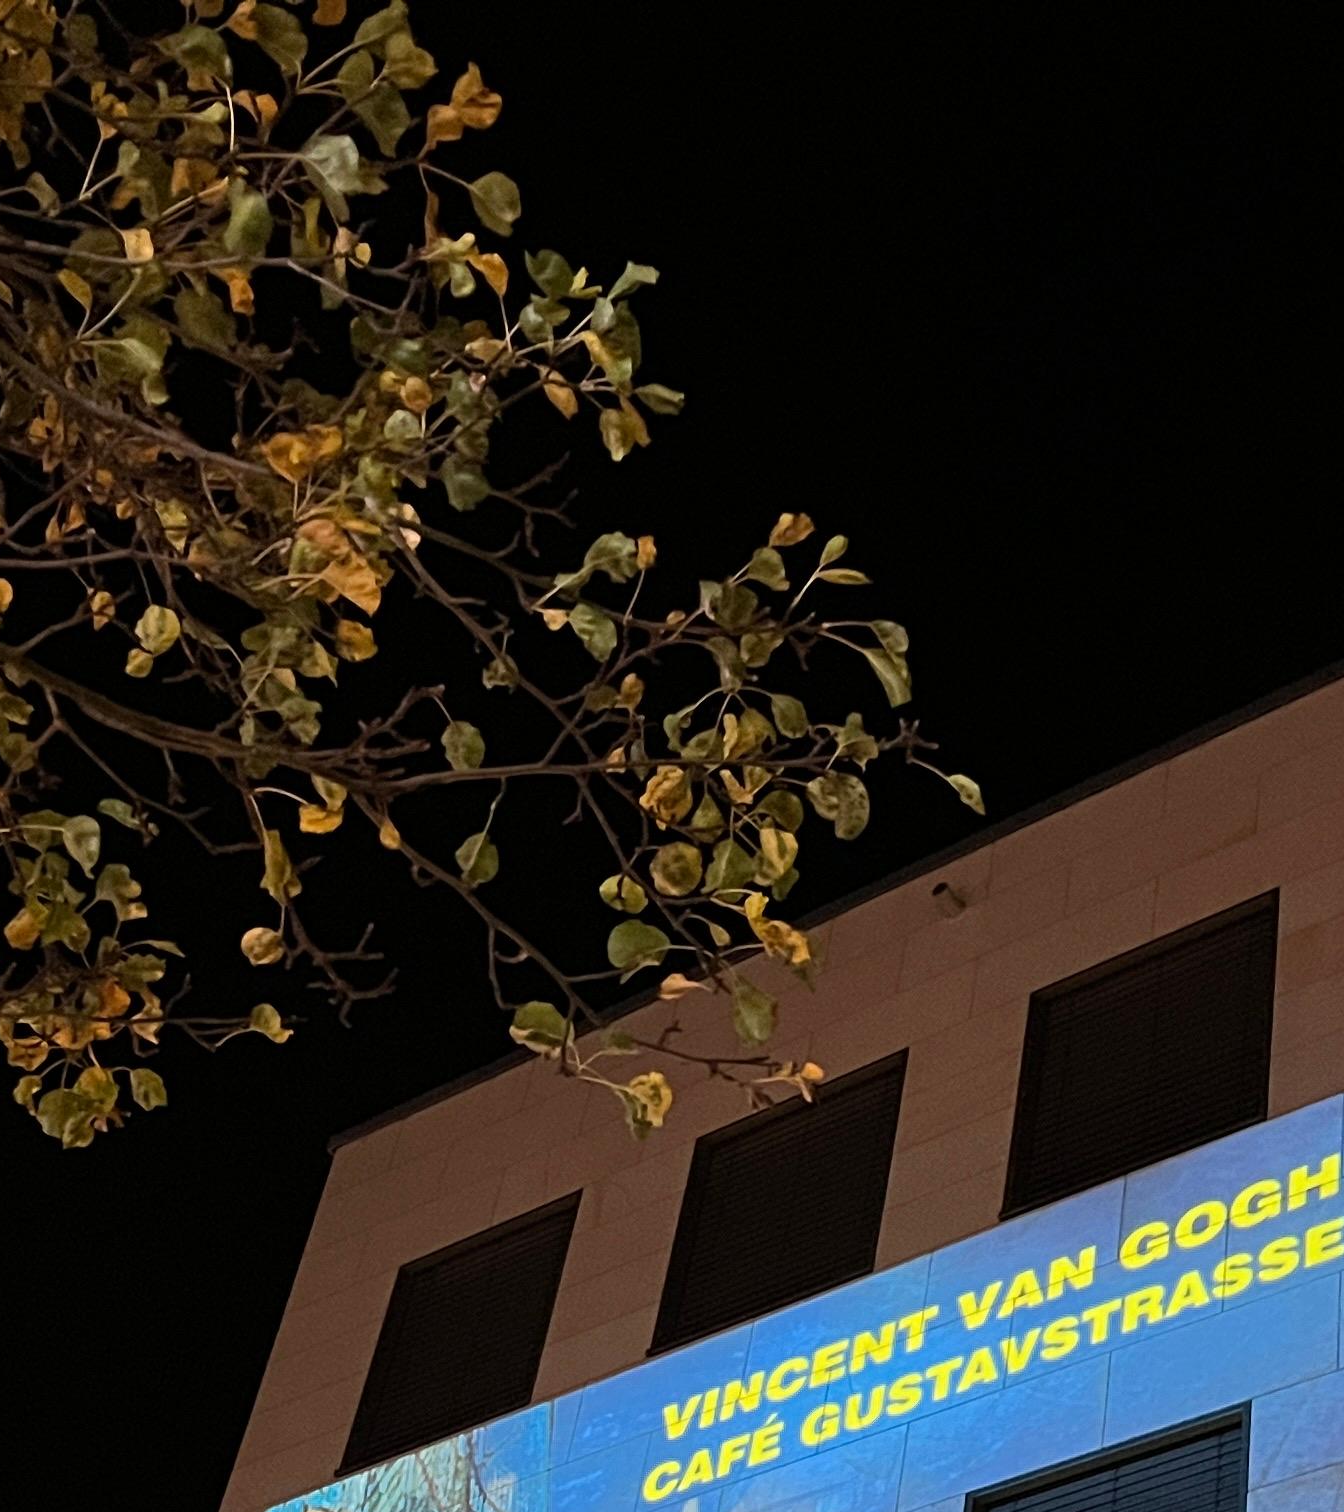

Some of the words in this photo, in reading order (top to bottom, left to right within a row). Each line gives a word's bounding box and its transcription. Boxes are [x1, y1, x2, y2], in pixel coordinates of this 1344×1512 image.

[663, 1306, 939, 1440] VINCENT
[958, 1246, 1096, 1330] VAN
[1118, 1153, 1342, 1270] GOGH
[642, 1413, 784, 1502] CAFÉ
